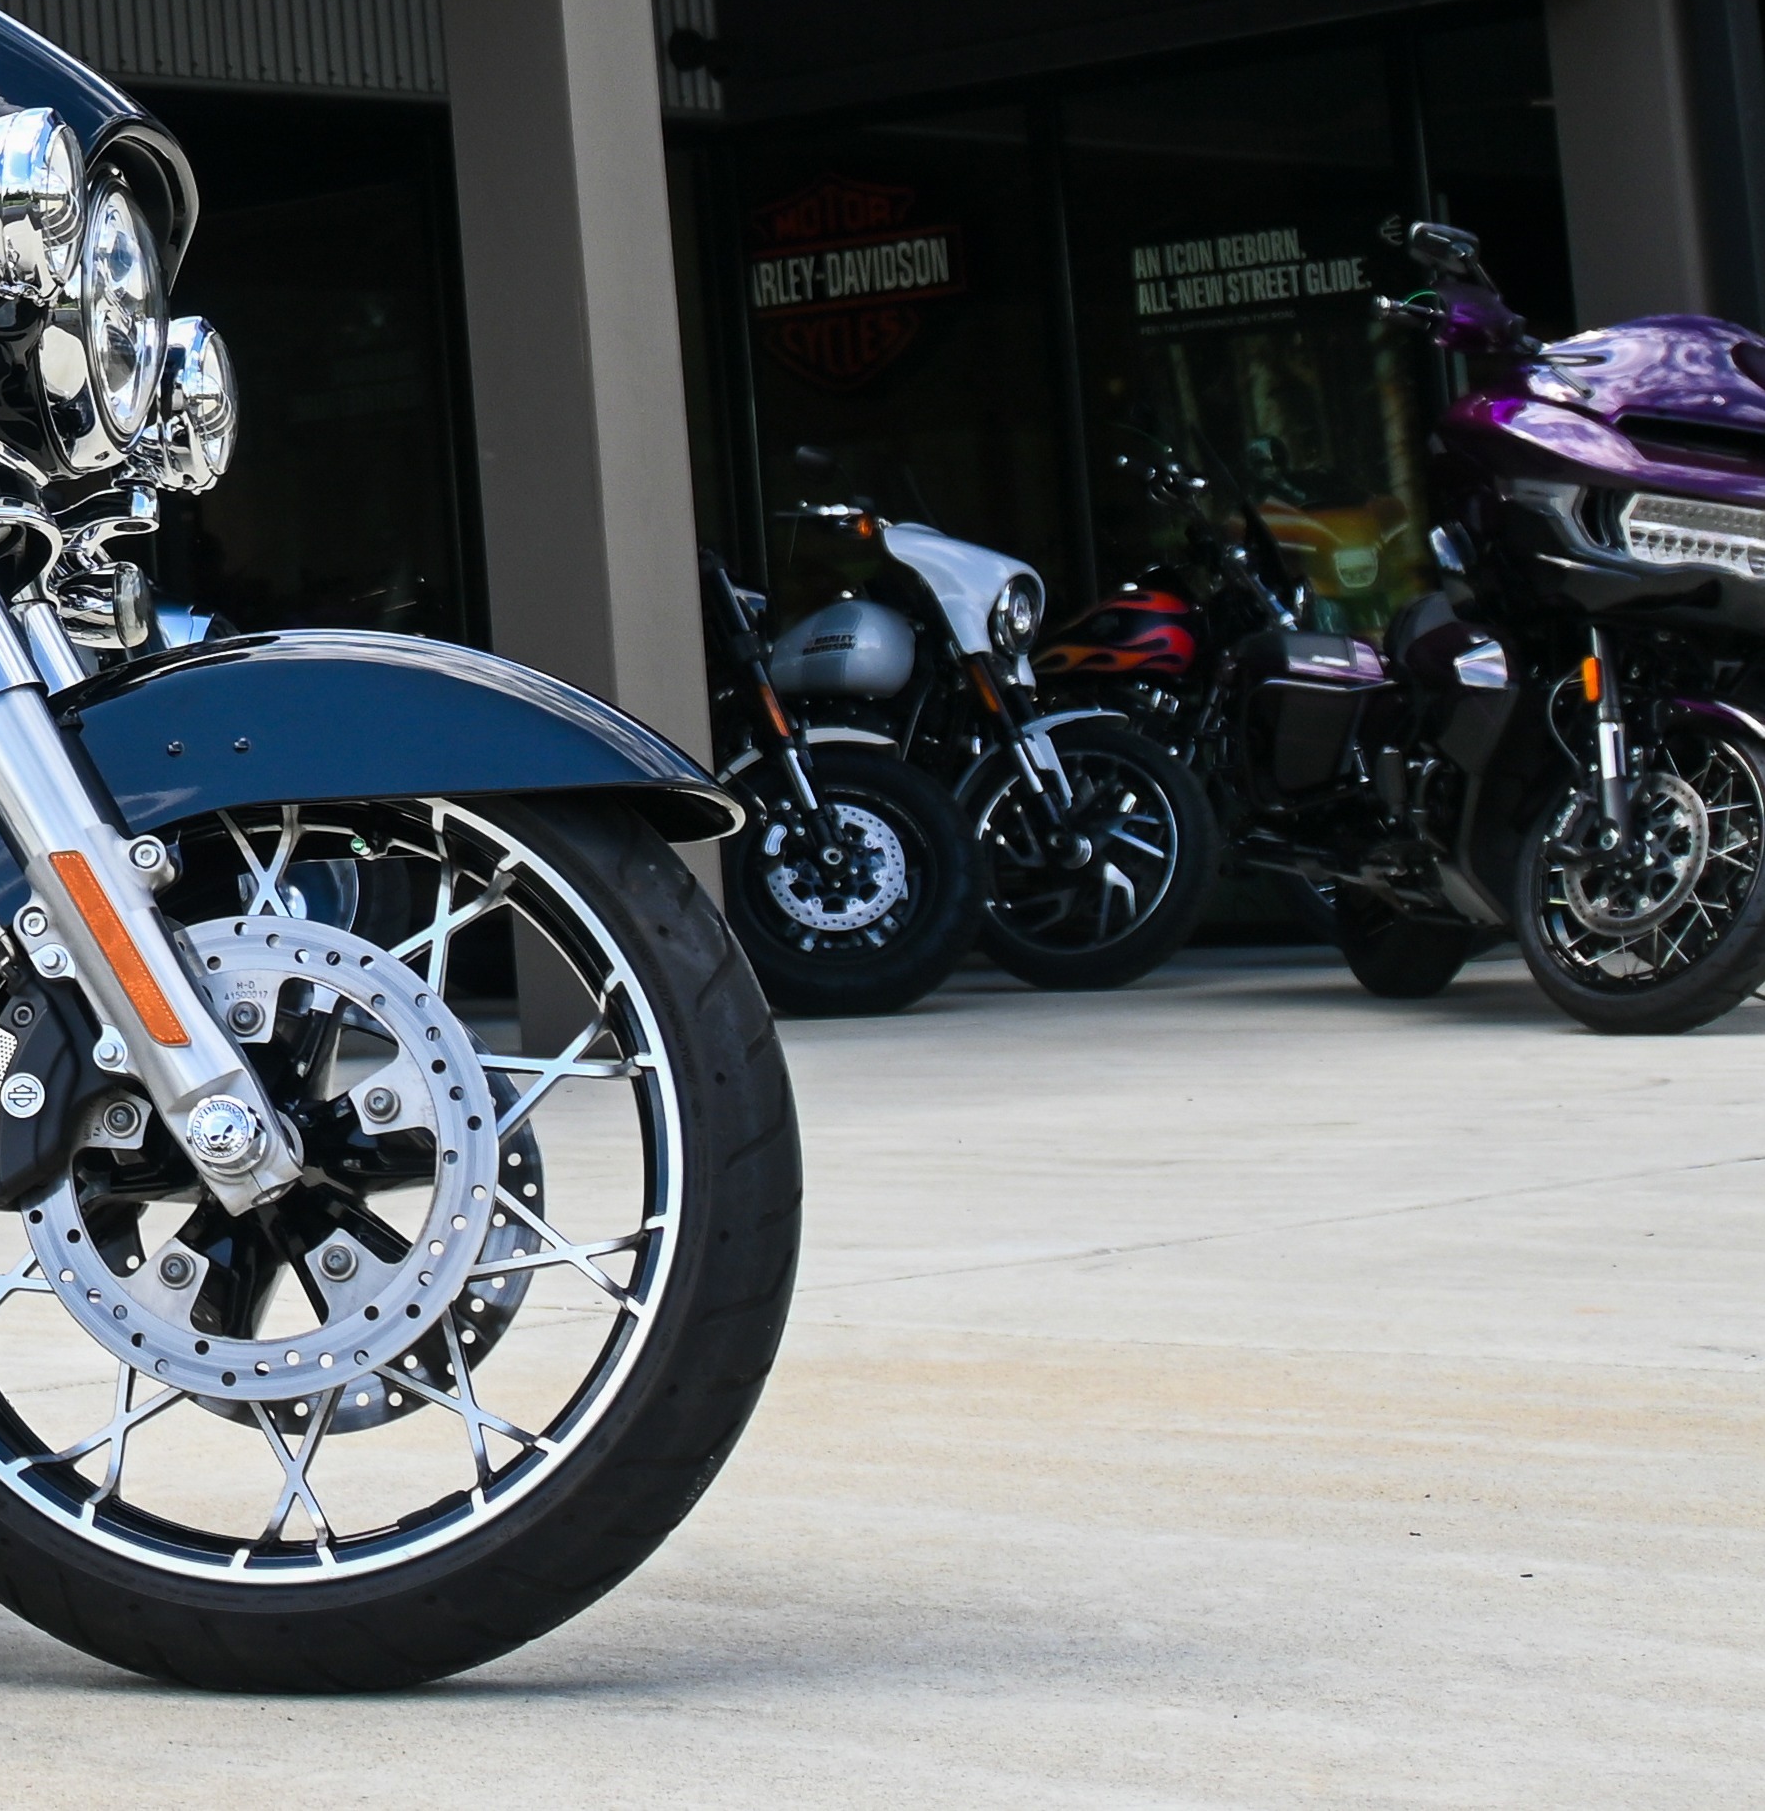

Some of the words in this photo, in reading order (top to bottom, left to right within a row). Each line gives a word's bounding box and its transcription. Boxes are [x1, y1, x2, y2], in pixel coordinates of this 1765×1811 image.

[775, 184, 893, 239] MOTOR
[751, 235, 949, 309] RLEY-DAVIDSON
[1132, 245, 1161, 280] AN
[1164, 239, 1215, 276] ICON
[1217, 227, 1308, 269] REBORN.
[1136, 273, 1225, 316] ALL-NEW
[1227, 264, 1301, 306] STREET
[1305, 257, 1373, 297] GLIDE.
[783, 310, 901, 375] CYCLES
